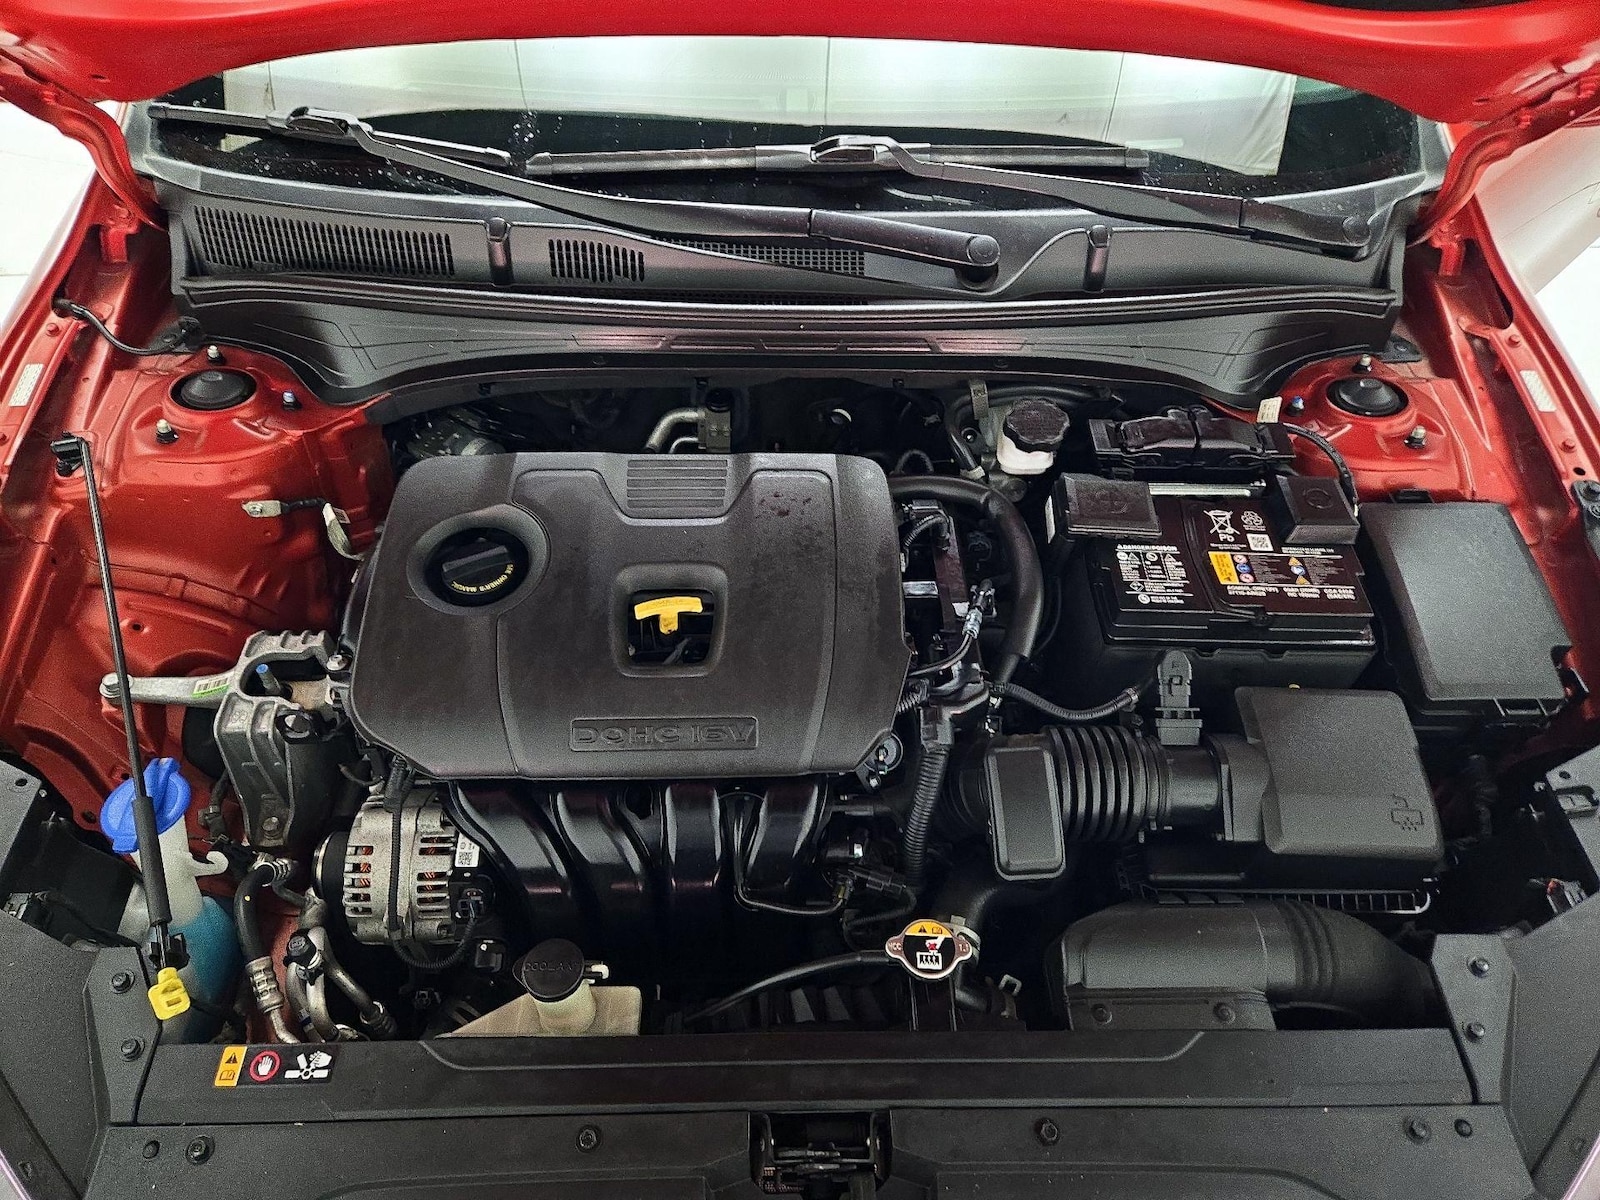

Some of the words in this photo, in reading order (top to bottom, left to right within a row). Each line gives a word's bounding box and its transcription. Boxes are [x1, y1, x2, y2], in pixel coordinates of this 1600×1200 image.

[1219, 534, 1235, 543] Pb
[573, 725, 681, 745] DOHC
[691, 724, 755, 743] 16V
